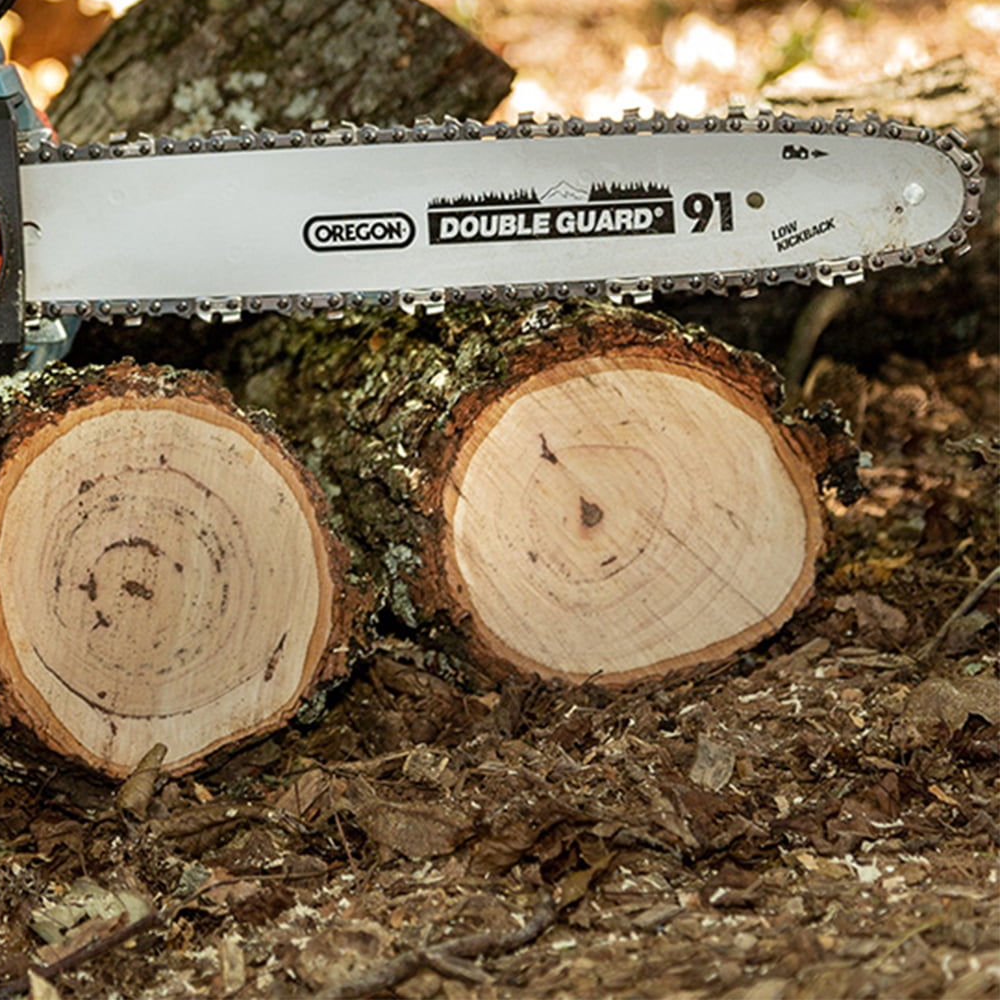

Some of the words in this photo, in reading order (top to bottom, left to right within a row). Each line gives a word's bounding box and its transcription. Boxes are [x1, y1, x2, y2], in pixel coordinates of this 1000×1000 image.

[439, 211, 550, 240] DOUBLE
[682, 191, 734, 234] 91
[315, 221, 402, 243] OREGON
[771, 219, 797, 241] LOW
[776, 217, 836, 252] KICKBACK
